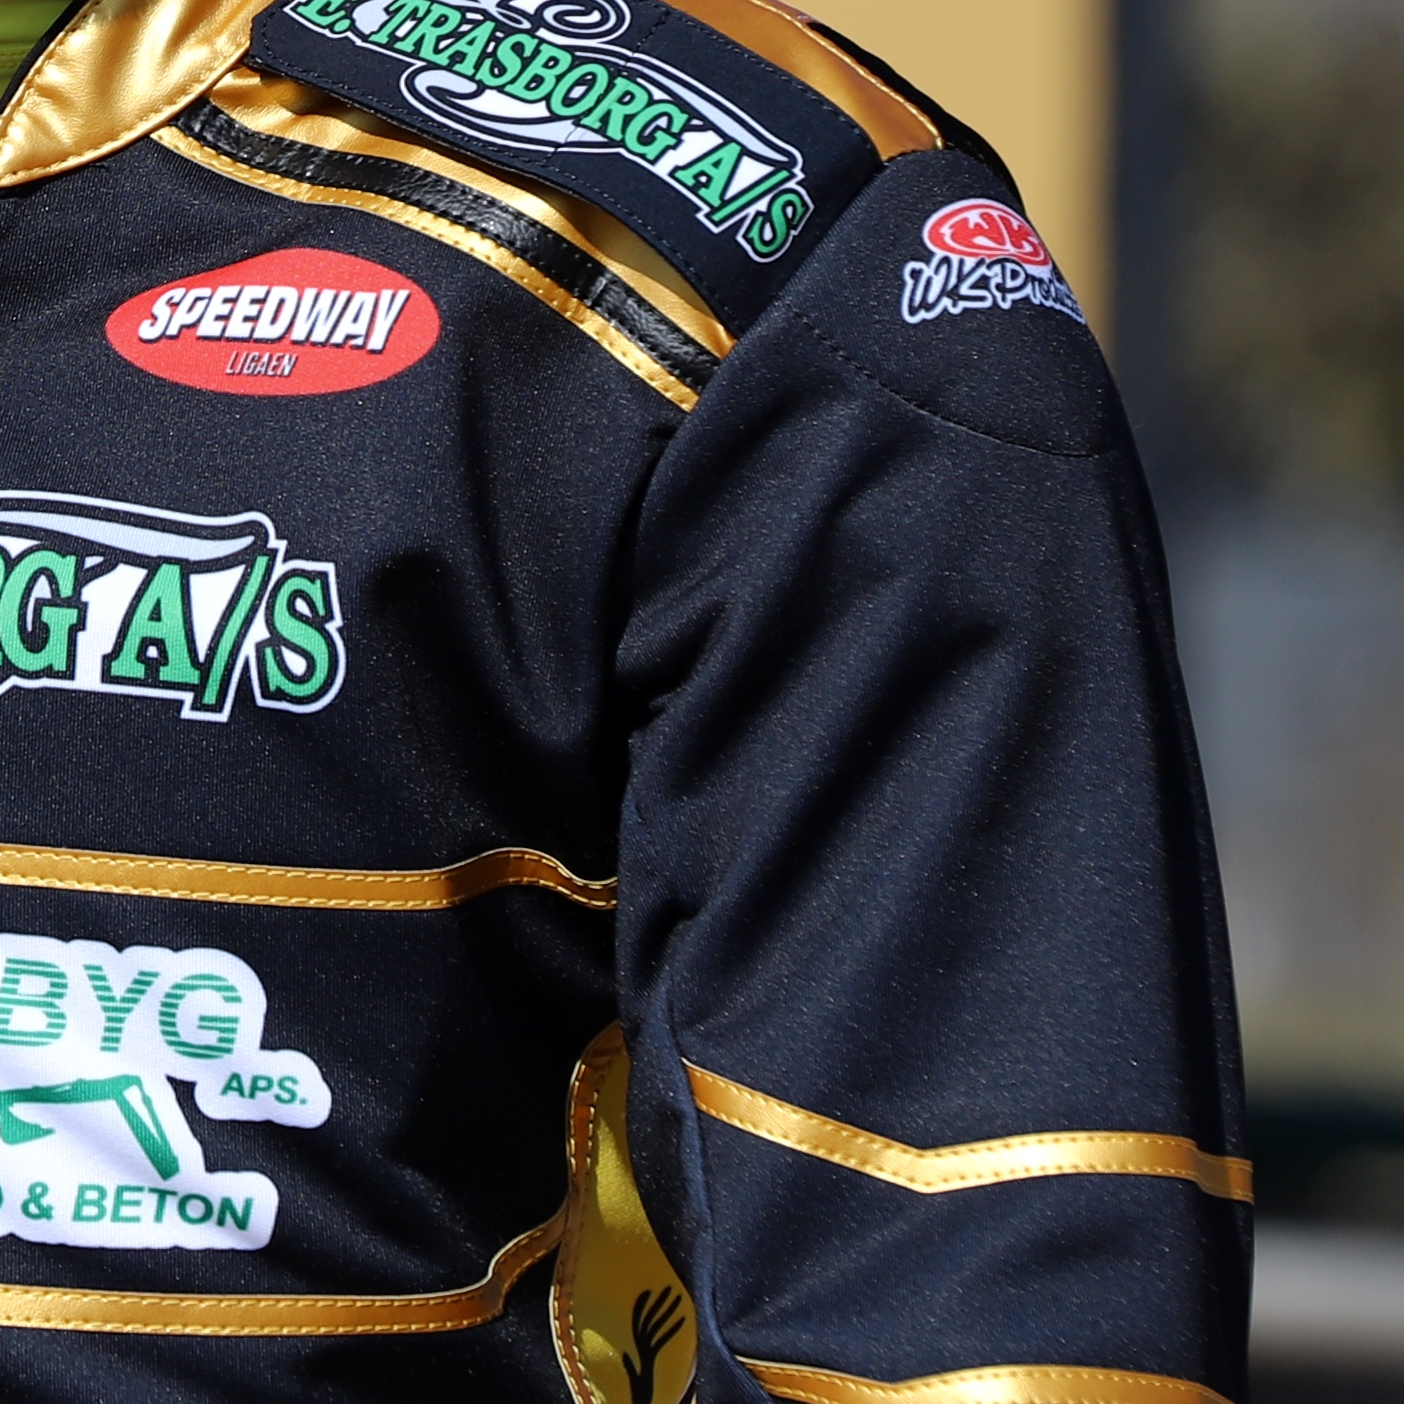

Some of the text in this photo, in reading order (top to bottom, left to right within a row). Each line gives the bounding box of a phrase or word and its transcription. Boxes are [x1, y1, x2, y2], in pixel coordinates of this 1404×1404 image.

[674, 140, 806, 254] A/S
[138, 284, 410, 353] SPEEDWAY
[225, 351, 297, 377] LIGAEN
[109, 553, 331, 706] A/S
[219, 1071, 310, 1108] APS.
[19, 1180, 56, 1223] &
[70, 1182, 256, 1233] BETON
